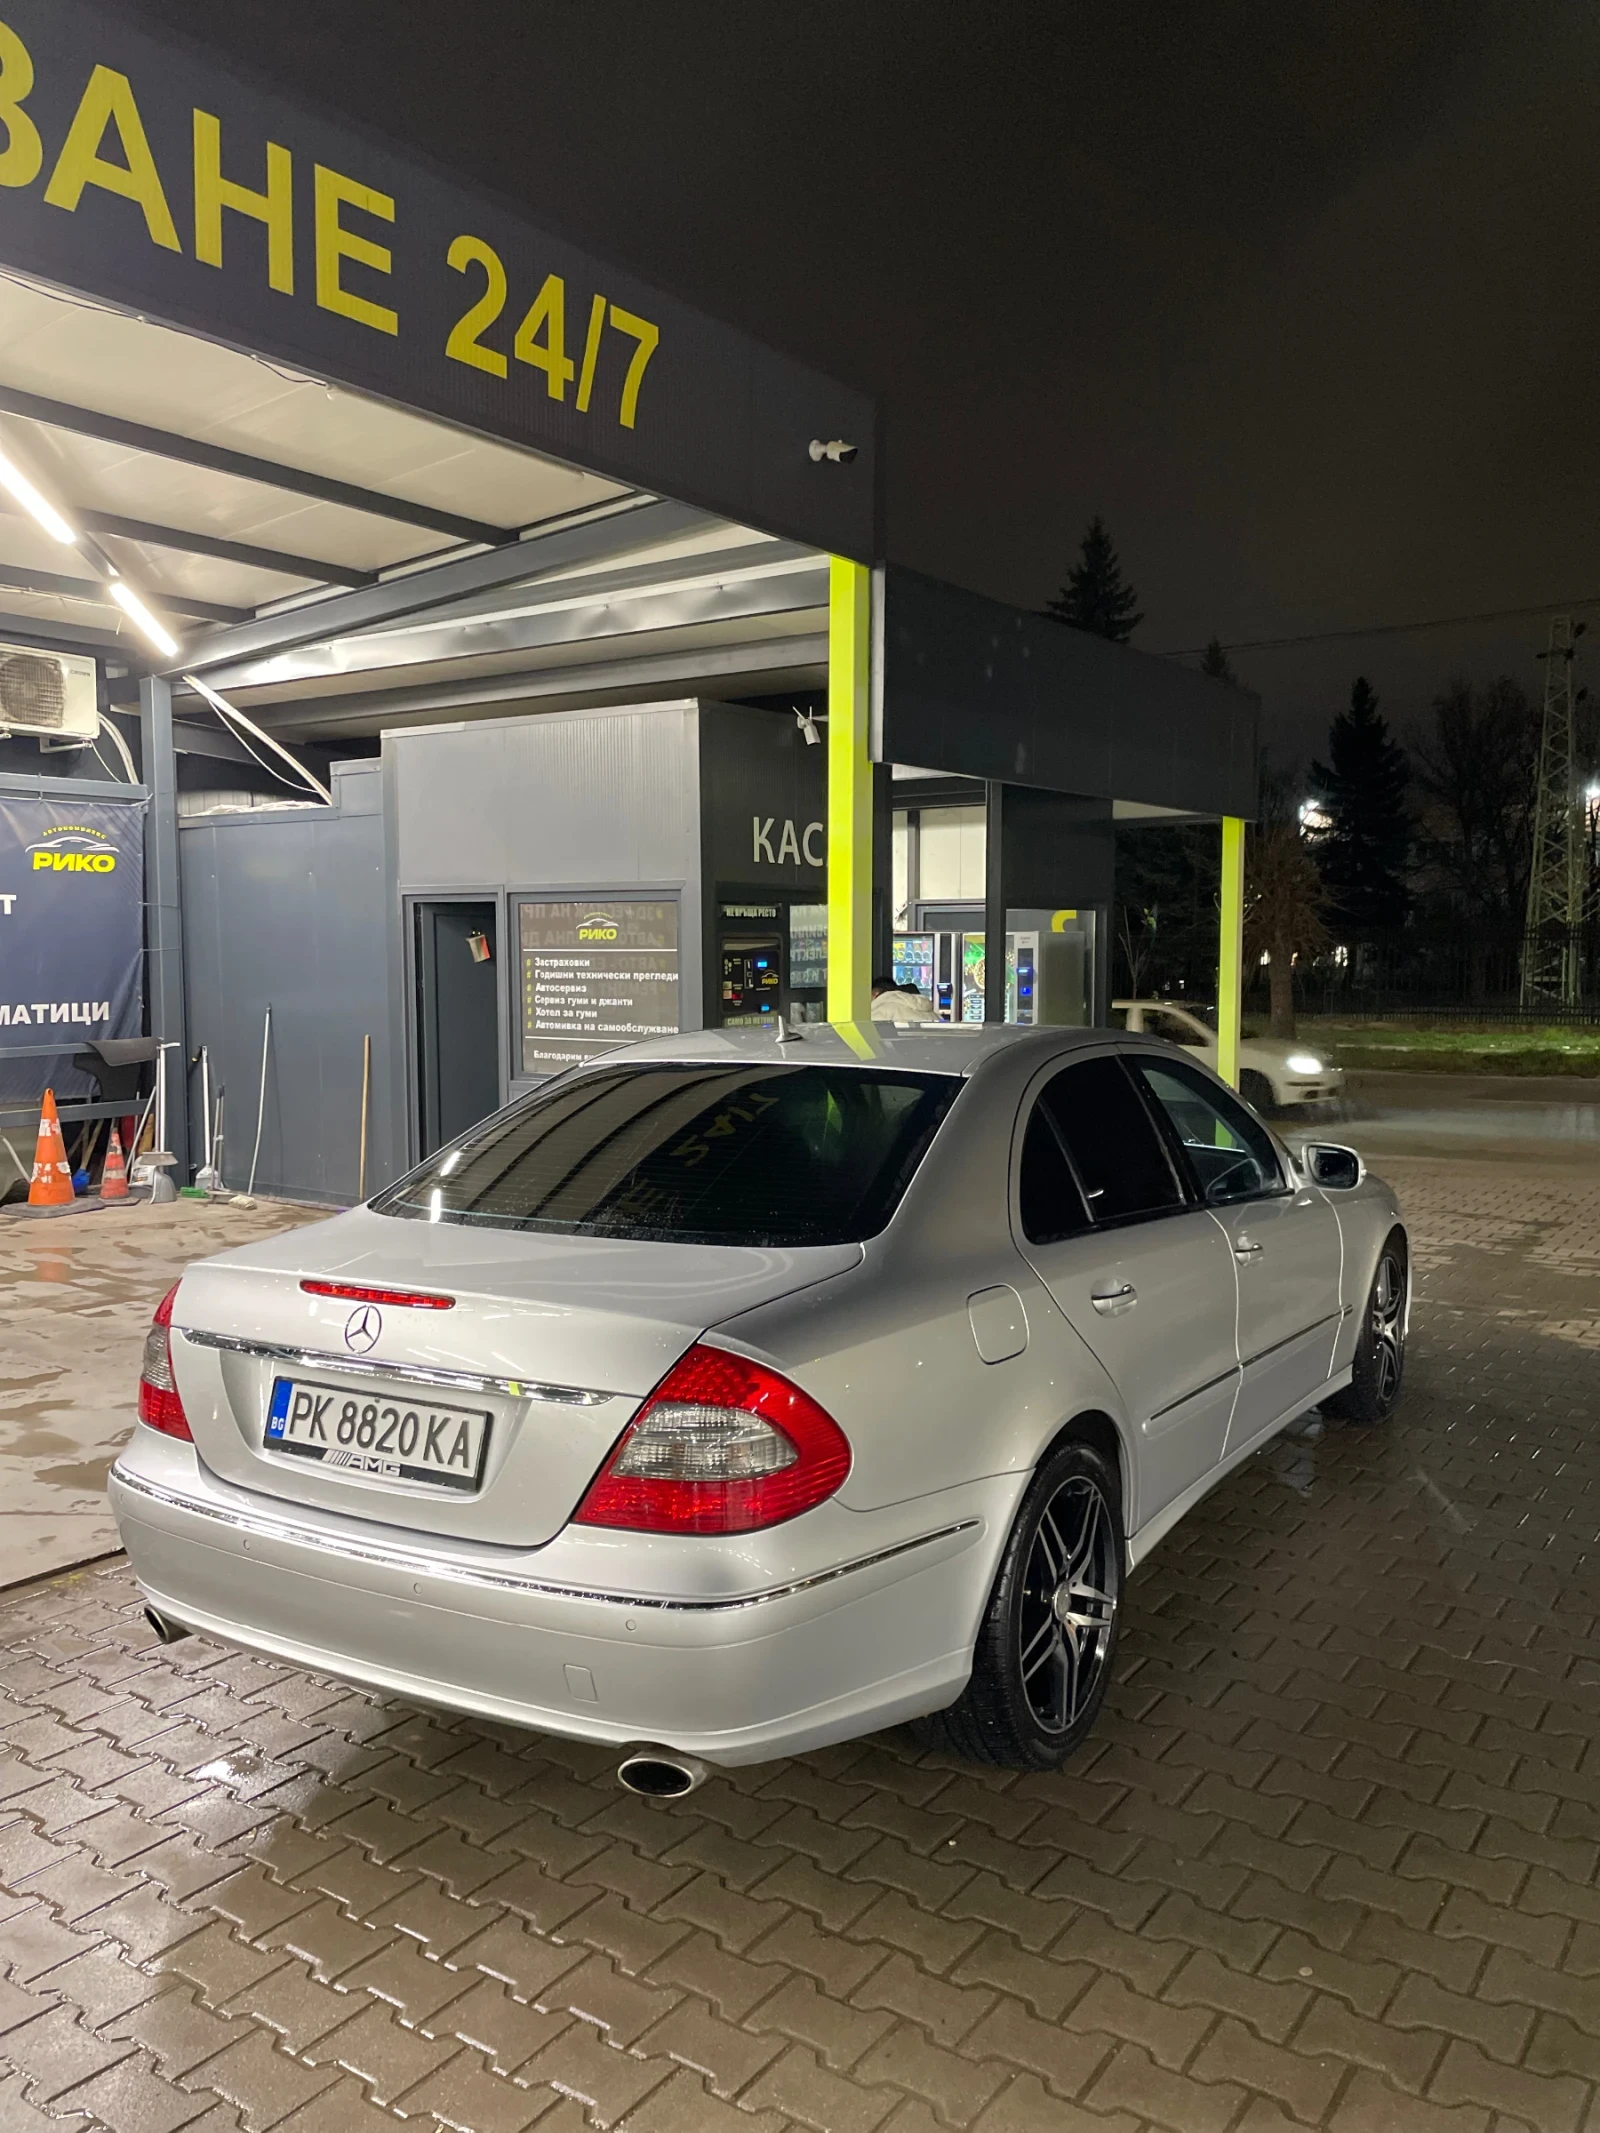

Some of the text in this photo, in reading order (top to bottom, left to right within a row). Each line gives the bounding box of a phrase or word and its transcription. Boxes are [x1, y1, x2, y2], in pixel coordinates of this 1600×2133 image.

[445, 235, 660, 430] 24/7
[753, 816, 828, 868] КАС
[33, 851, 116, 873] РИКО
[579, 928, 617, 940] РИКО
[534, 957, 590, 968] Застраховки
[534, 970, 679, 982] Годишни технически прегледи
[535, 982, 587, 994] Автосервиз
[534, 995, 565, 1005] Сервиз
[567, 997, 588, 1007] гуми
[599, 998, 633, 1007] джанти
[535, 1007, 561, 1017] Хотел
[576, 1010, 598, 1019] гуми
[535, 1020, 679, 1035] Автомивка на самообслужване
[533, 1050, 582, 1062] Благодарим
[270, 1416, 285, 1431] BG
[289, 1391, 470, 1469] PK 8820 KA
[347, 1453, 401, 1478] AMG
